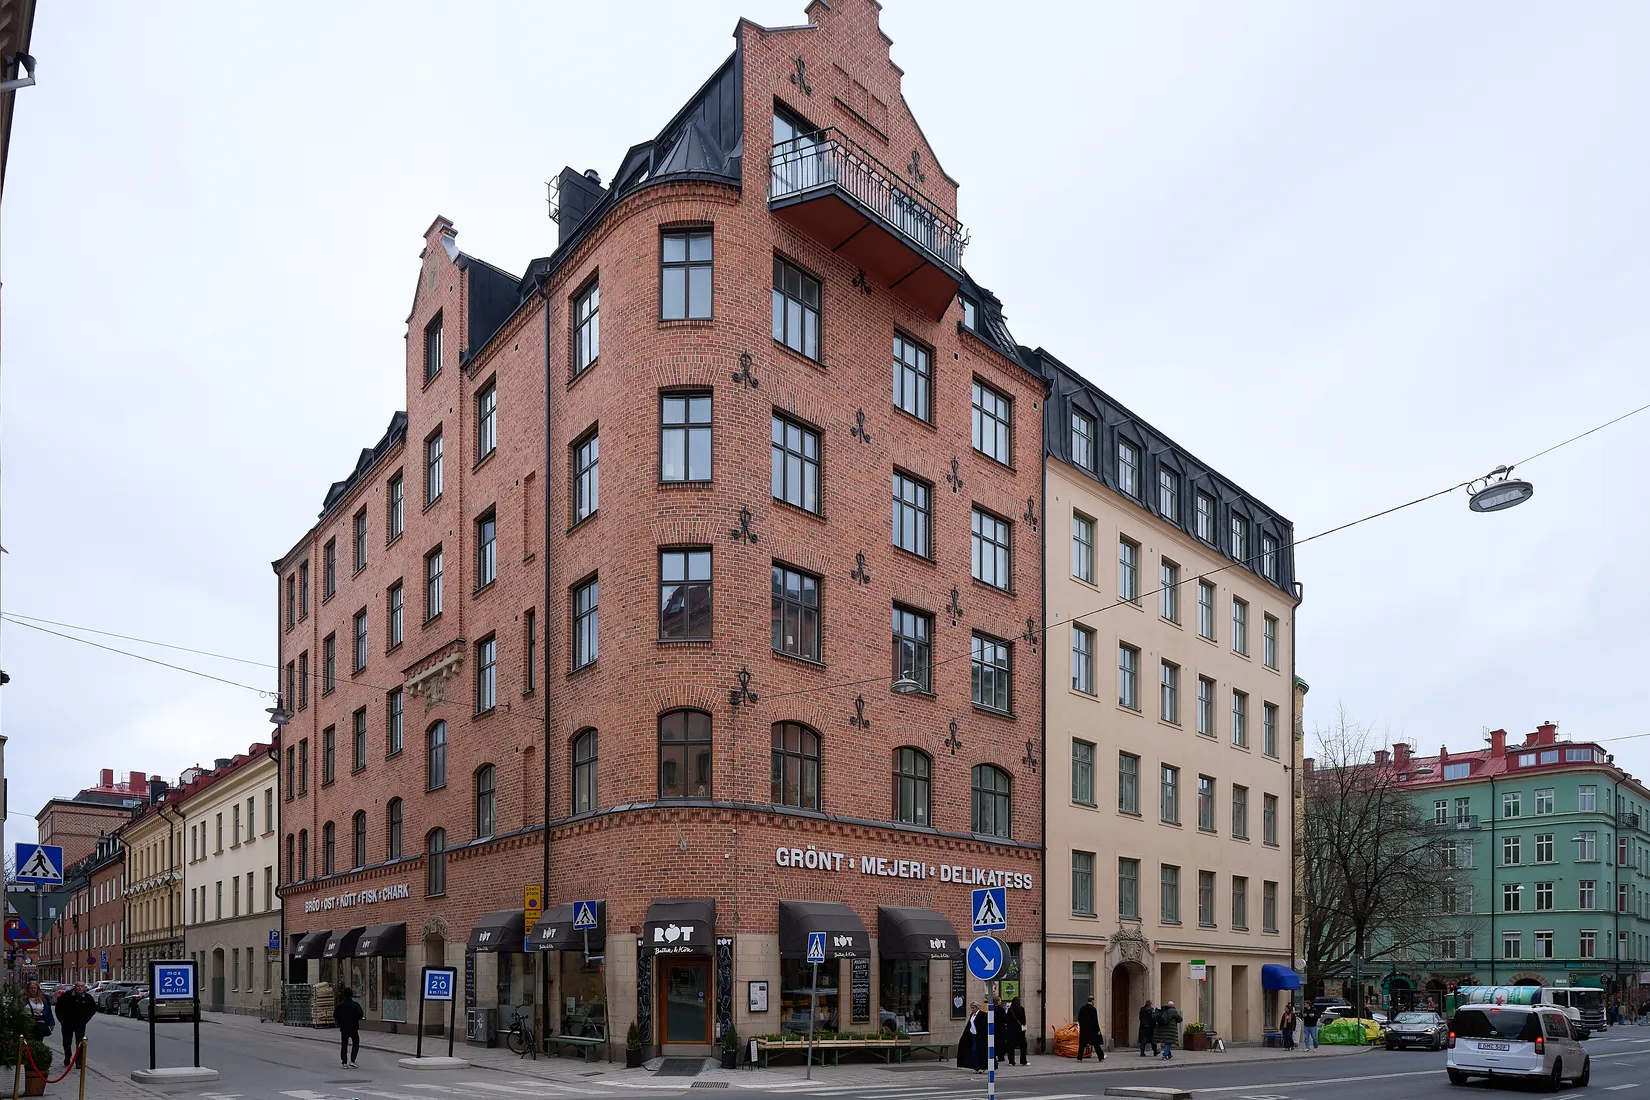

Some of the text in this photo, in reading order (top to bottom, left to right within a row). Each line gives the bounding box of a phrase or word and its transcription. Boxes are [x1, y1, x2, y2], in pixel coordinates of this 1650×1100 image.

[776, 845, 1033, 890] GRÖNT MEJERI DELIKATESS
[305, 884, 409, 913] BRÖD OST KÖTT FISK CHARK
[271, 931, 278, 940] P
[164, 976, 185, 987] 20
[431, 980, 447, 990] 20
